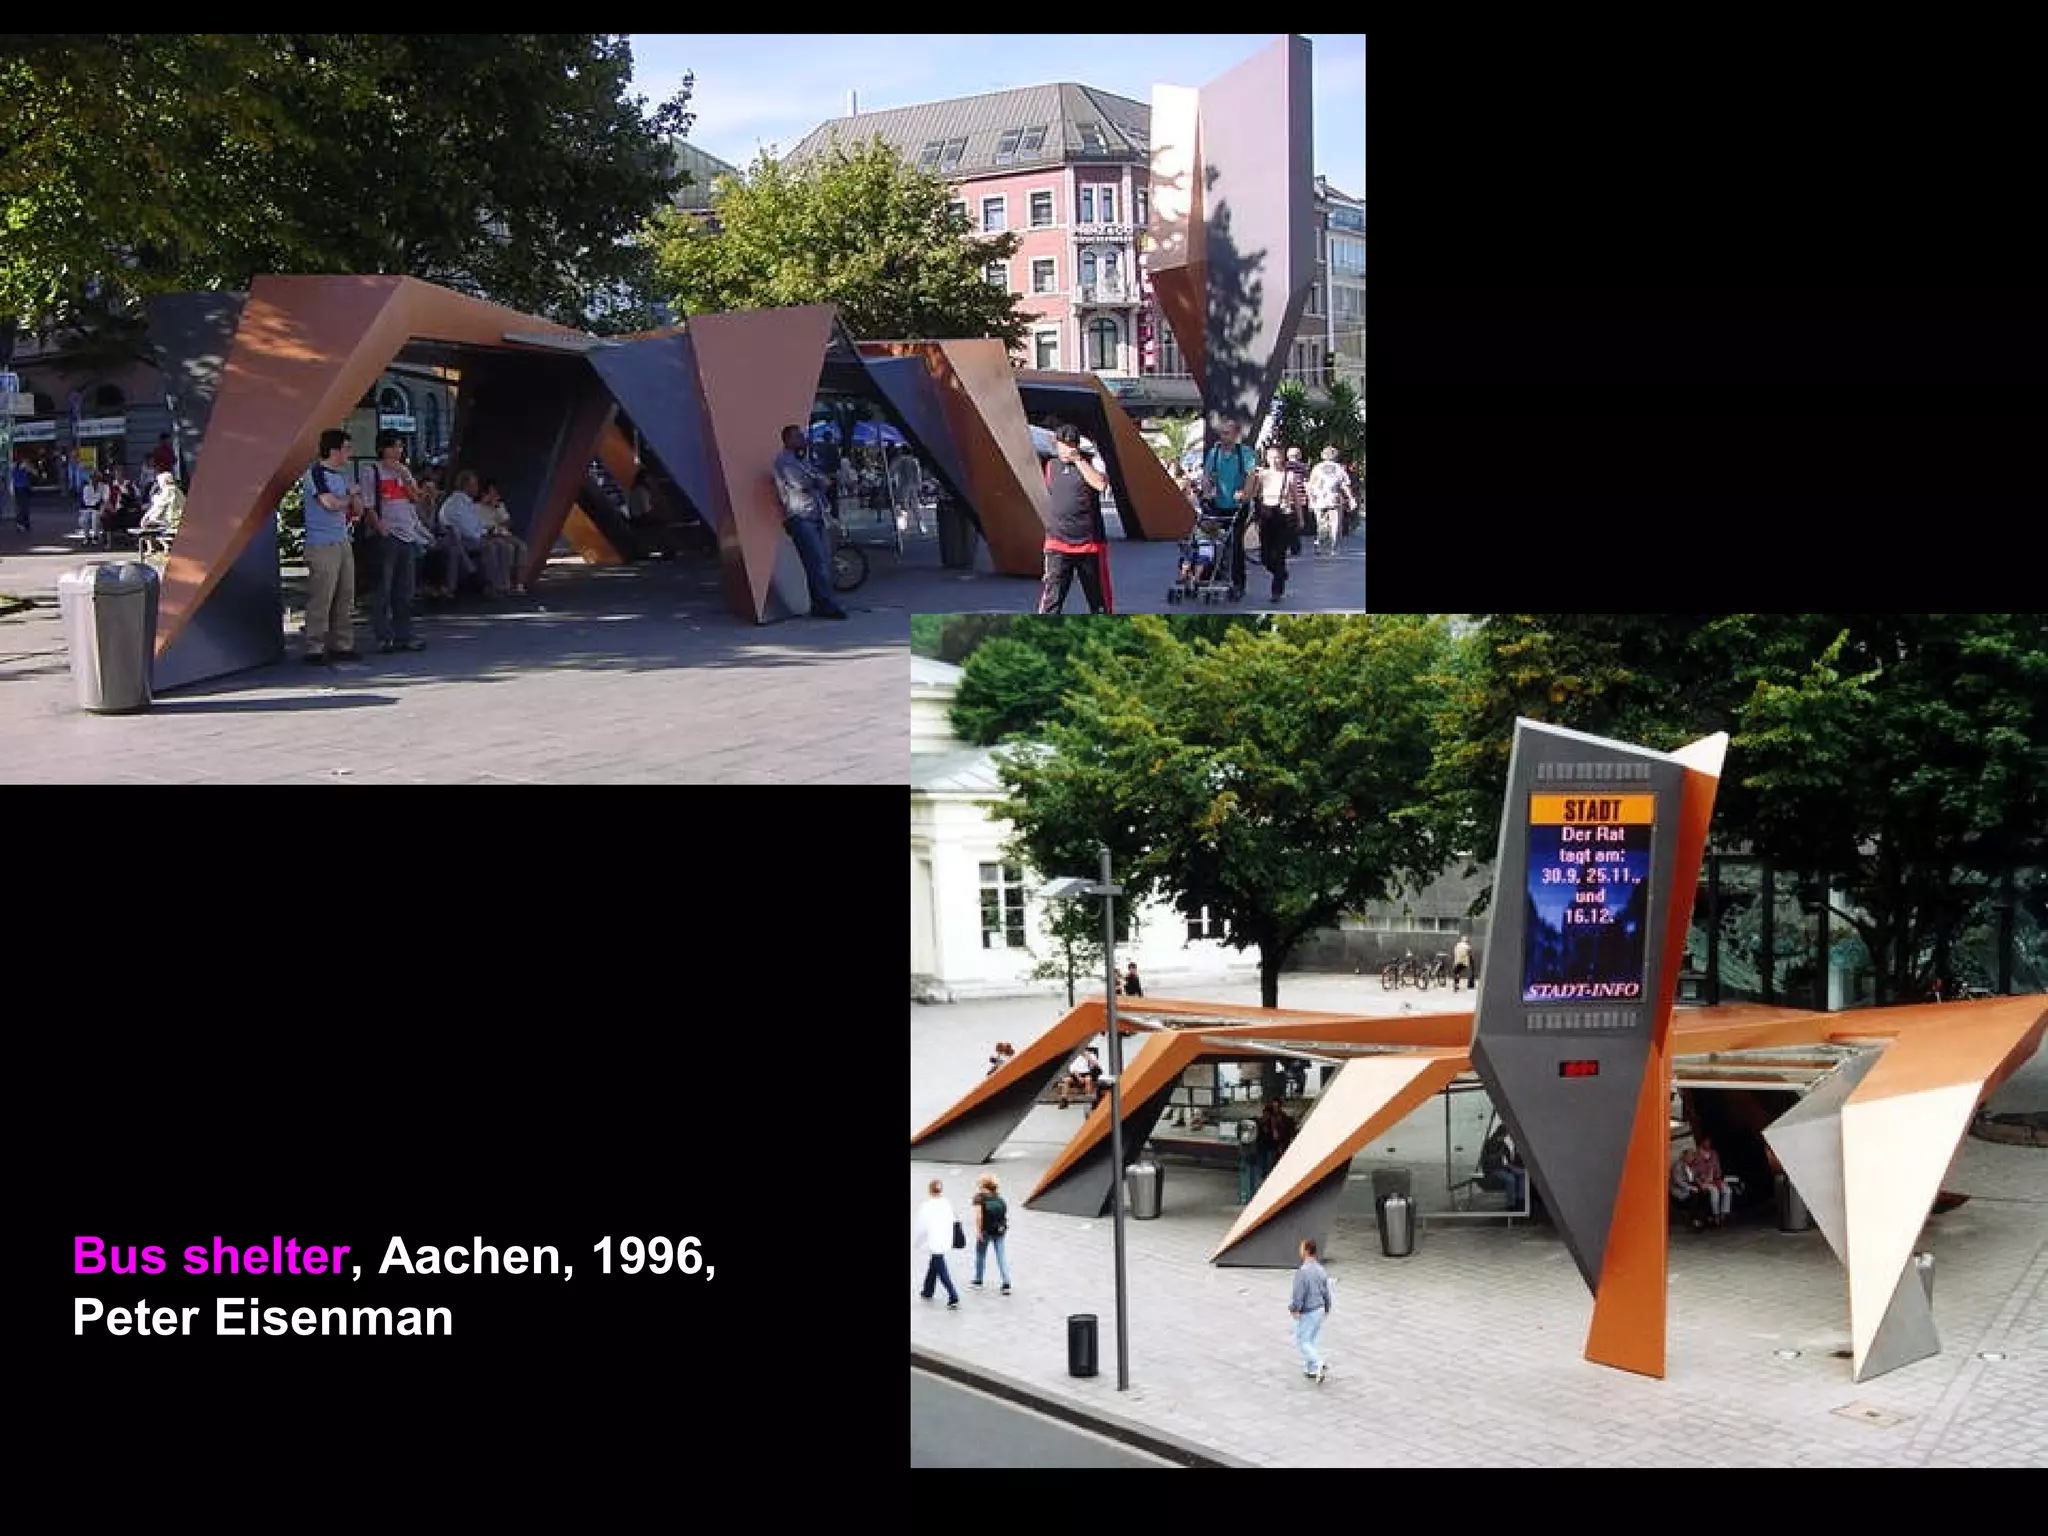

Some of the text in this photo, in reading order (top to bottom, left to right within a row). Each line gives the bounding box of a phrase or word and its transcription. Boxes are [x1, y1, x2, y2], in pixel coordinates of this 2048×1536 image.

[1564, 799, 1623, 822] STADT
[1561, 826, 1625, 842] Der Rat
[1559, 848, 1626, 865] tagt am:
[1575, 887, 1607, 904] und
[1566, 908, 1615, 925] 16.12.
[1528, 982, 1640, 998] STADT-INFO
